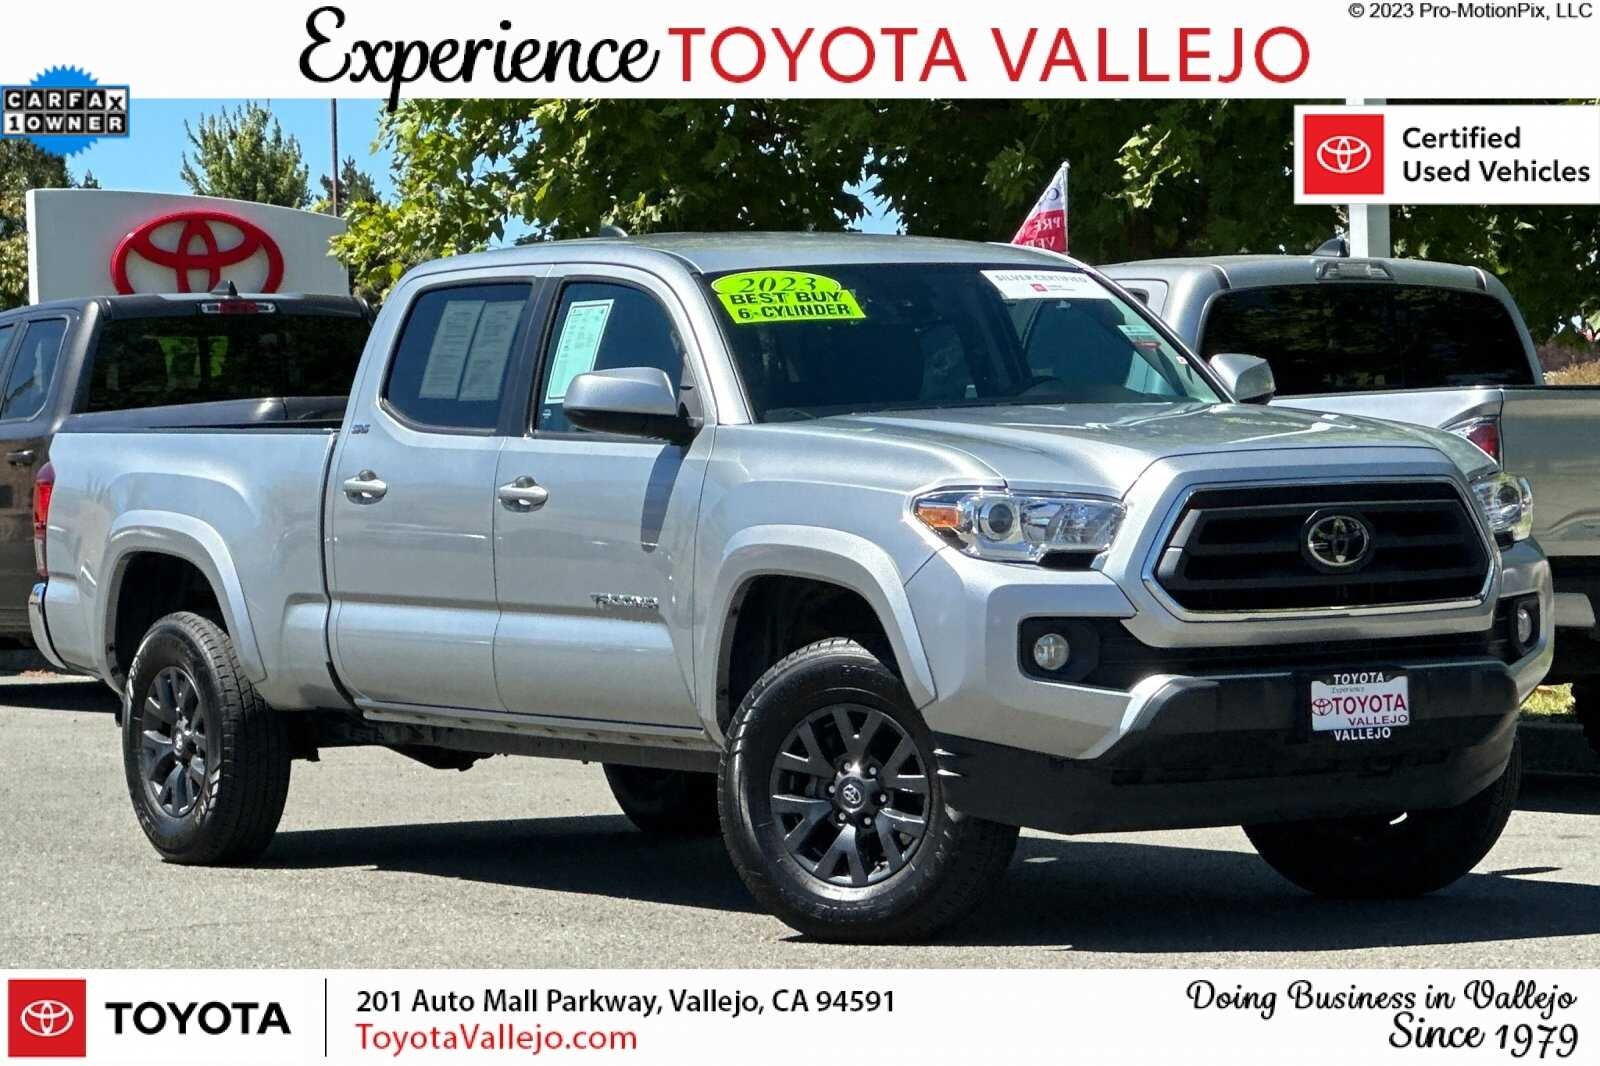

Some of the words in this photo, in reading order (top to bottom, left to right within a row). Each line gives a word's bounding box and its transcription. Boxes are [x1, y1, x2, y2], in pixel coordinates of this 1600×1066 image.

[738, 276, 818, 293] 2023
[730, 291, 788, 305] BEST
[796, 290, 841, 303] BUY
[1333, 672, 1384, 685] TOYOTA
[1332, 693, 1407, 715] TOYOTA
[1348, 714, 1408, 726] VALLEJO
[1333, 726, 1391, 741] VALLEJO
